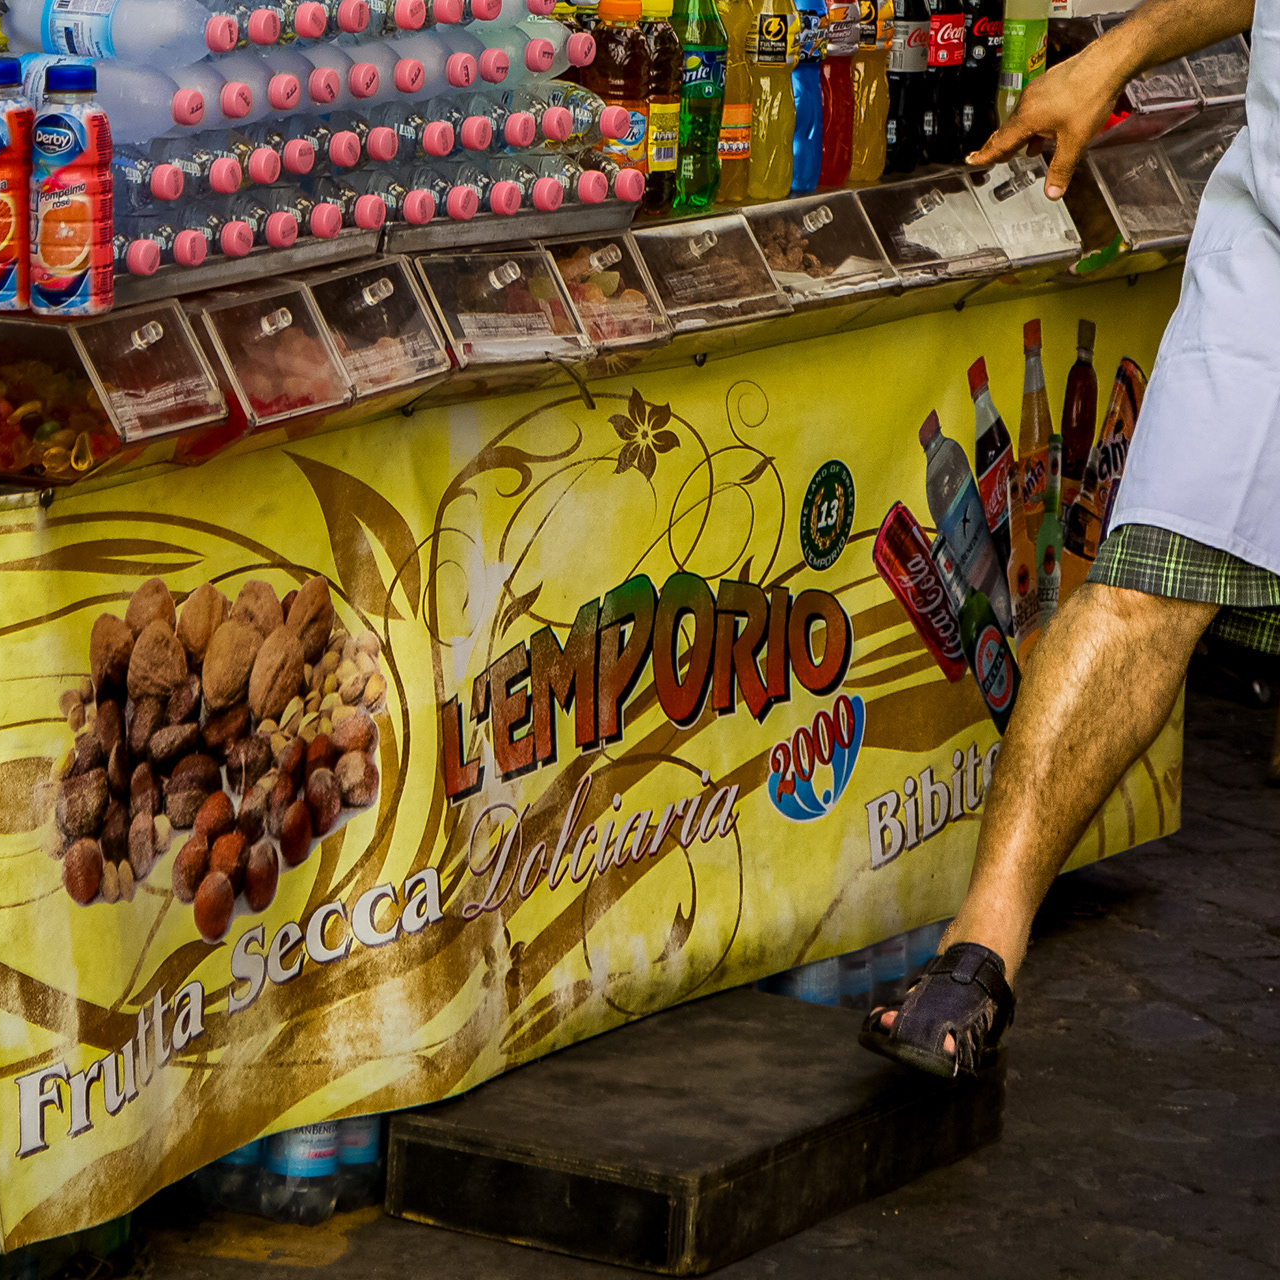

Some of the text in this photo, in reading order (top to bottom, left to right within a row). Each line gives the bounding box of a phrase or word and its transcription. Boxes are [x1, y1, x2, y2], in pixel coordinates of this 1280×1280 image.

[35, 130, 70, 147] Derby
[39, 182, 86, 203] Pompelmo
[801, 506, 809, 536] THE
[807, 468, 827, 500] LAND
[1022, 459, 1047, 504] anta
[817, 498, 839, 529] 13
[804, 535, 846, 569] L'EMPORIO
[442, 571, 855, 807] L'EMPORIO
[769, 692, 856, 804] 2000
[461, 767, 744, 921] Dolciaria
[15, 863, 444, 1161] Frutta Secca
